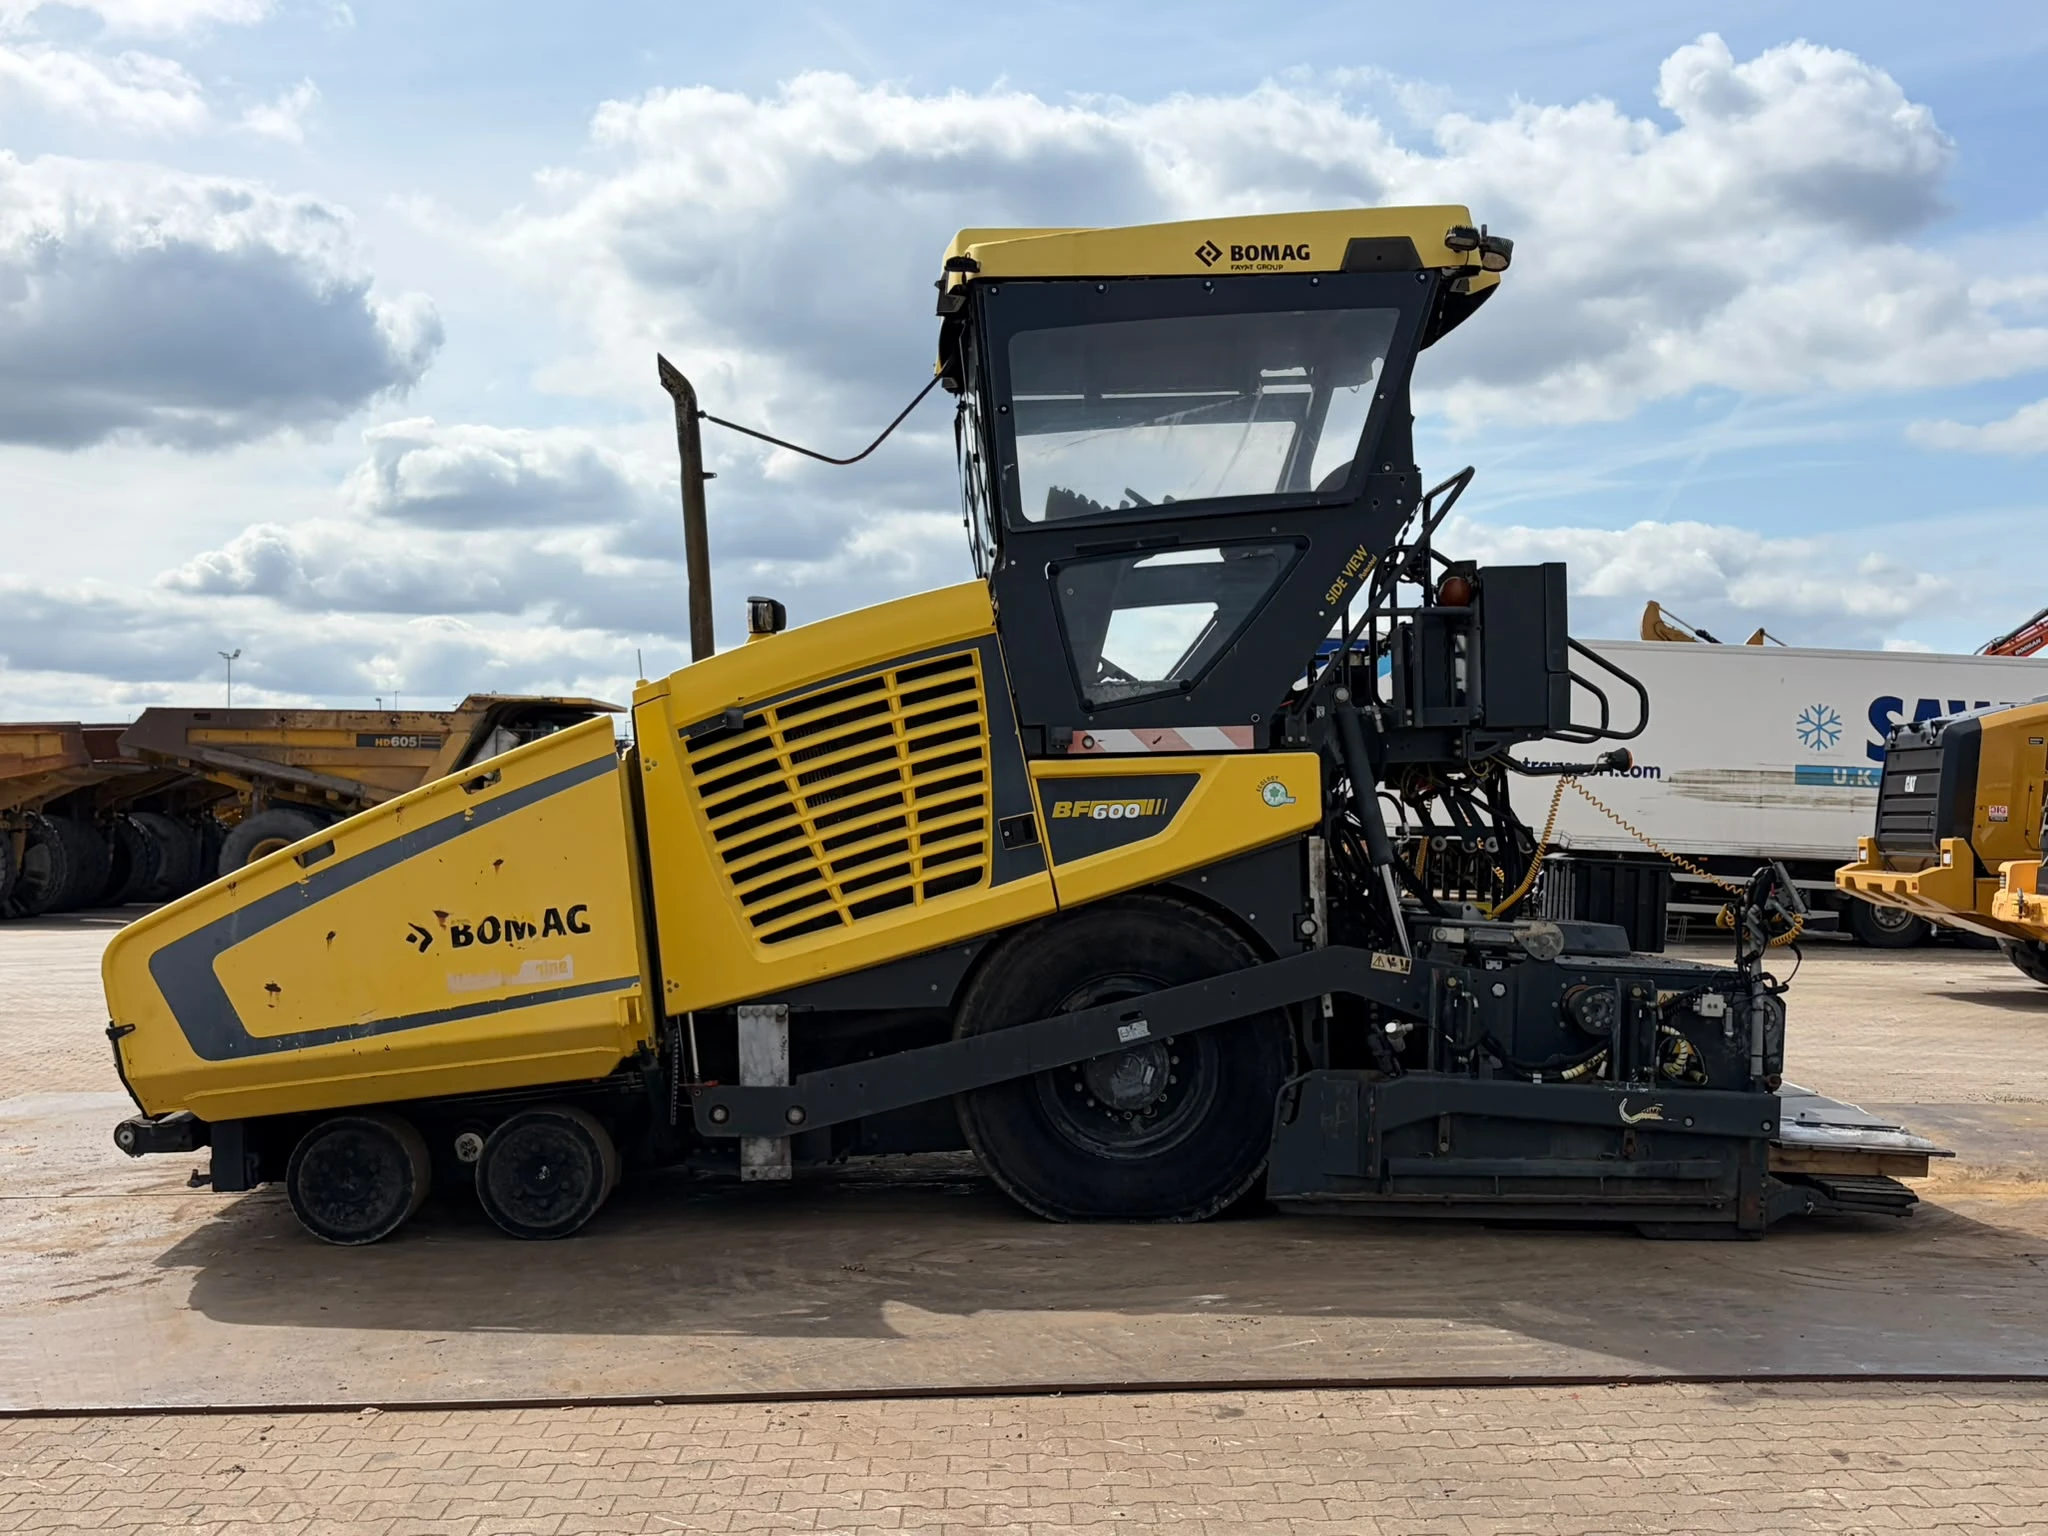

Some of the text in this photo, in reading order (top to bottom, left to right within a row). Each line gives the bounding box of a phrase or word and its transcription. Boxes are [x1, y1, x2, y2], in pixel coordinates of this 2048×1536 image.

[1230, 244, 1311, 261] BOMAG
[1325, 544, 1368, 605] SIDE VIEW
[375, 736, 417, 747] HD605
[1832, 768, 1878, 786] U.K.
